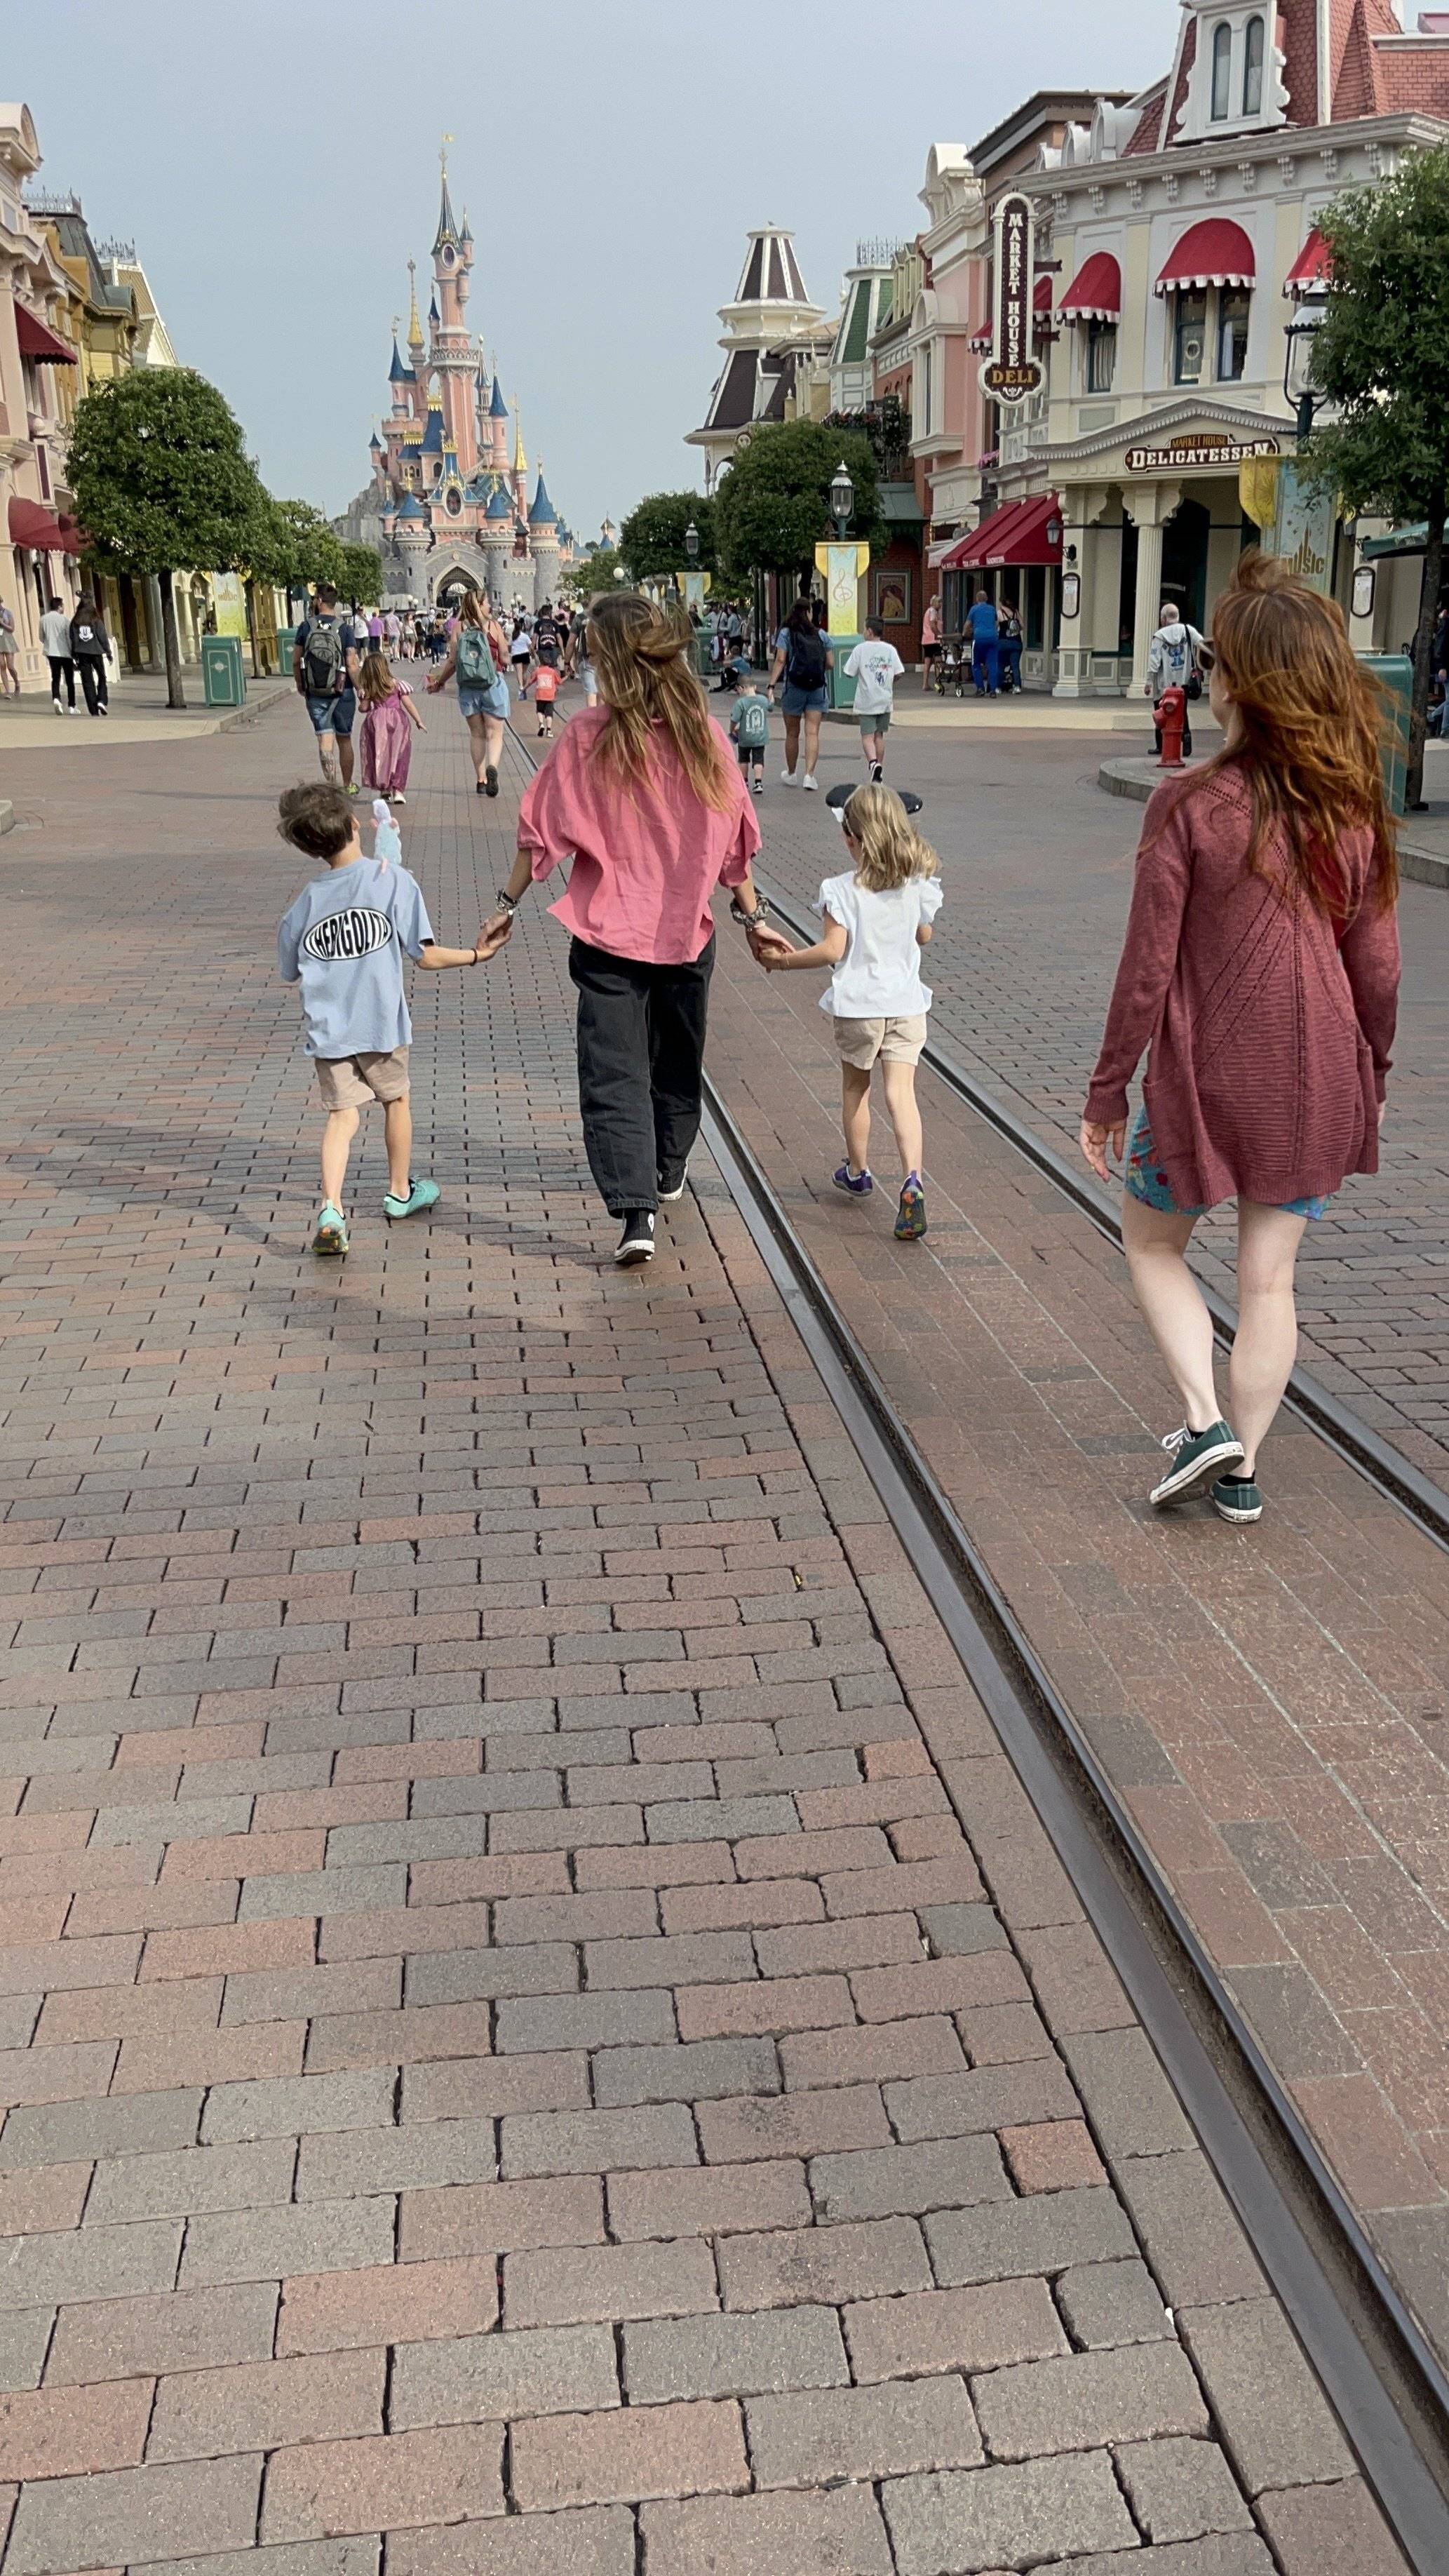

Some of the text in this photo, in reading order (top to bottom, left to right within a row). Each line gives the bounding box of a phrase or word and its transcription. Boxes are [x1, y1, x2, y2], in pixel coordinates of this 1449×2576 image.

[1008, 213, 1023, 367] MARKET HOUSE
[992, 370, 1033, 384] DELI
[1172, 435, 1226, 448] MARKET HOUSE
[1131, 443, 1269, 469] DELICATESSEN
